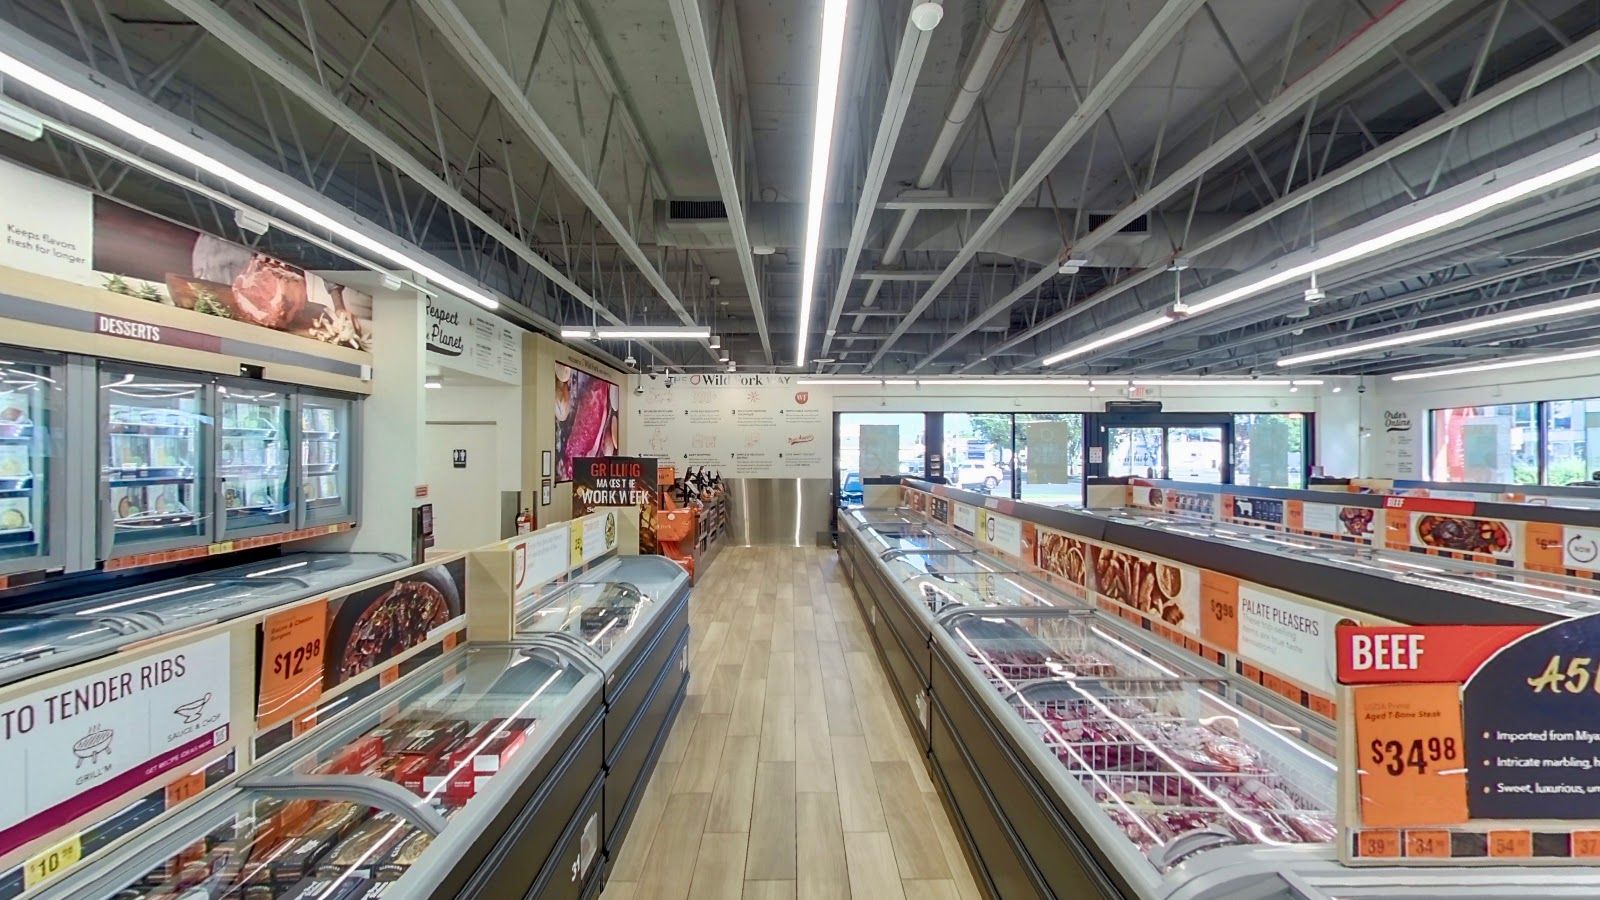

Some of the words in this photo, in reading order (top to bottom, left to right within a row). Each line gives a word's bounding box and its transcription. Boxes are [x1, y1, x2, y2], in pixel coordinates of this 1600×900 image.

[7, 224, 40, 240] Keeps
[42, 234, 76, 251] flavors
[7, 236, 33, 251] fresh
[35, 244, 51, 255] for
[53, 248, 86, 264] longer
[99, 316, 160, 341] DESSERTS
[737, 374, 764, 386] ork
[1384, 410, 1407, 420] Order
[582, 490, 617, 504] WORK
[1242, 598, 1270, 620] PALATE
[1272, 608, 1320, 637] PLEASERS
[1352, 634, 1425, 670] BEEF
[1527, 655, 1592, 693] A5
[1, 704, 35, 740] TO
[44, 672, 133, 724] TENDER
[141, 654, 186, 690] RIBS
[1365, 711, 1386, 722] Aged
[1388, 710, 1416, 719] T-Bone
[1418, 710, 1441, 718] Steak
[1497, 730, 1547, 743] Imported
[1549, 729, 1574, 741] from
[1575, 731, 1600, 743] Miya
[1497, 757, 1541, 767] Intricate
[1542, 757, 1591, 769] marbling,
[1497, 783, 1533, 794] Sweet,
[1535, 782, 1585, 794] luxurious,
